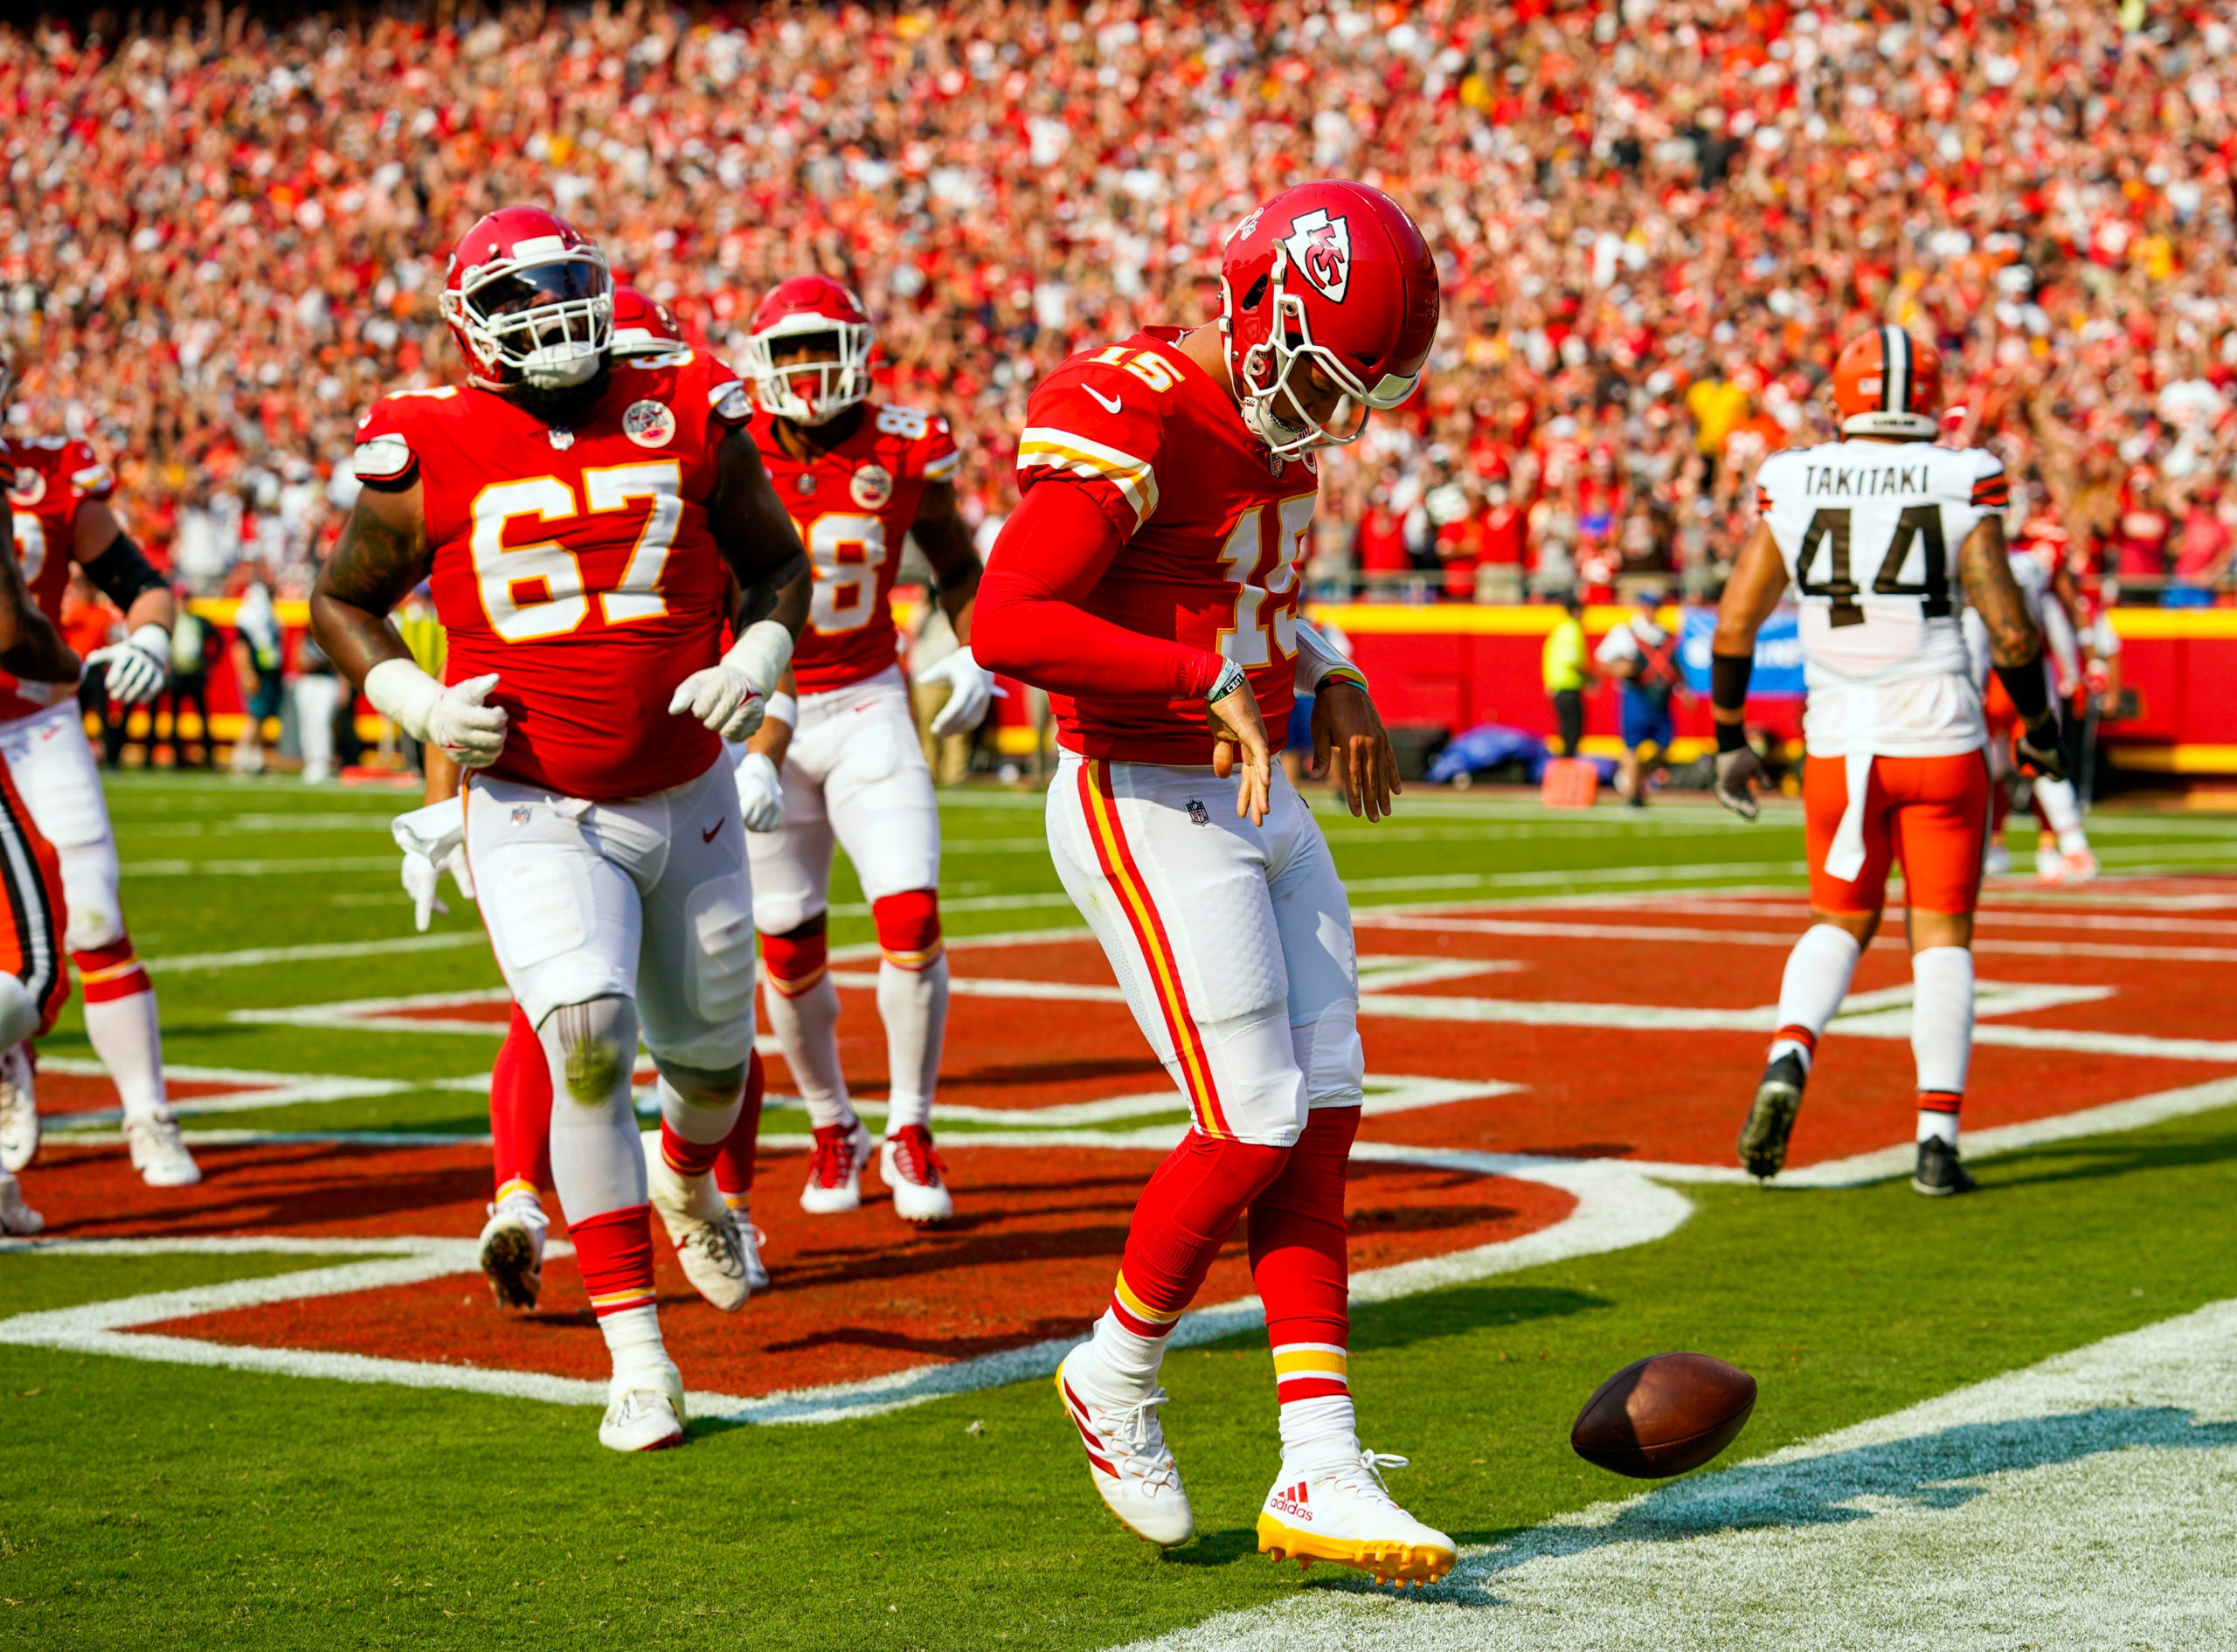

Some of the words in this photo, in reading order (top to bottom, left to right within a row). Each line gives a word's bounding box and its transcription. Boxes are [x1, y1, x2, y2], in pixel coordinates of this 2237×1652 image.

[1084, 346, 1187, 394] 15
[1805, 465, 1929, 496] TAKITAKI
[468, 457, 685, 644] 67
[789, 511, 888, 636] 8
[1215, 489, 1319, 670] 15
[1796, 502, 1952, 628] 44
[1270, 1496, 1313, 1522] adidas
